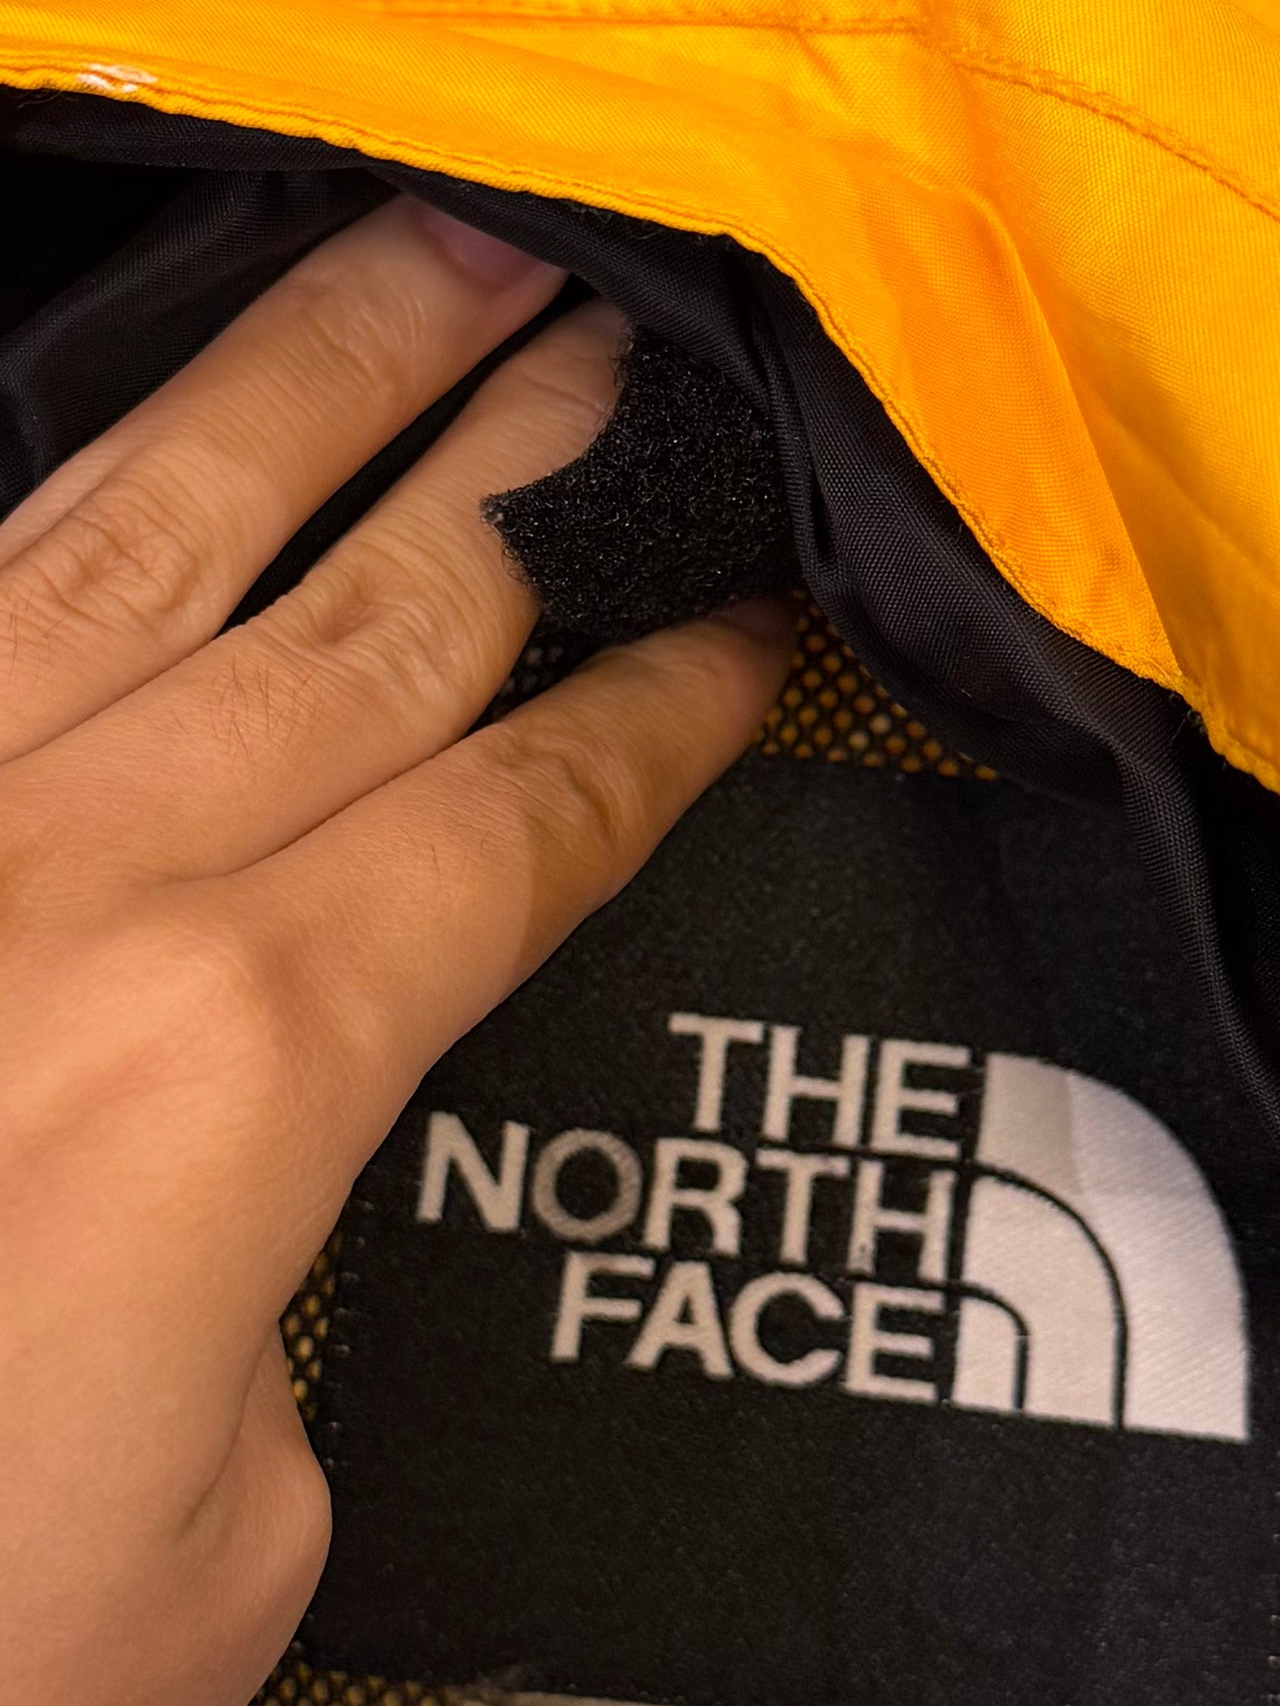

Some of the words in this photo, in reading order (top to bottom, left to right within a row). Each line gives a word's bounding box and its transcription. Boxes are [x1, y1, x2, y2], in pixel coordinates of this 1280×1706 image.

[667, 1011, 970, 1161] THE
[415, 1110, 958, 1285] NORTH
[550, 1249, 939, 1406] FACE
